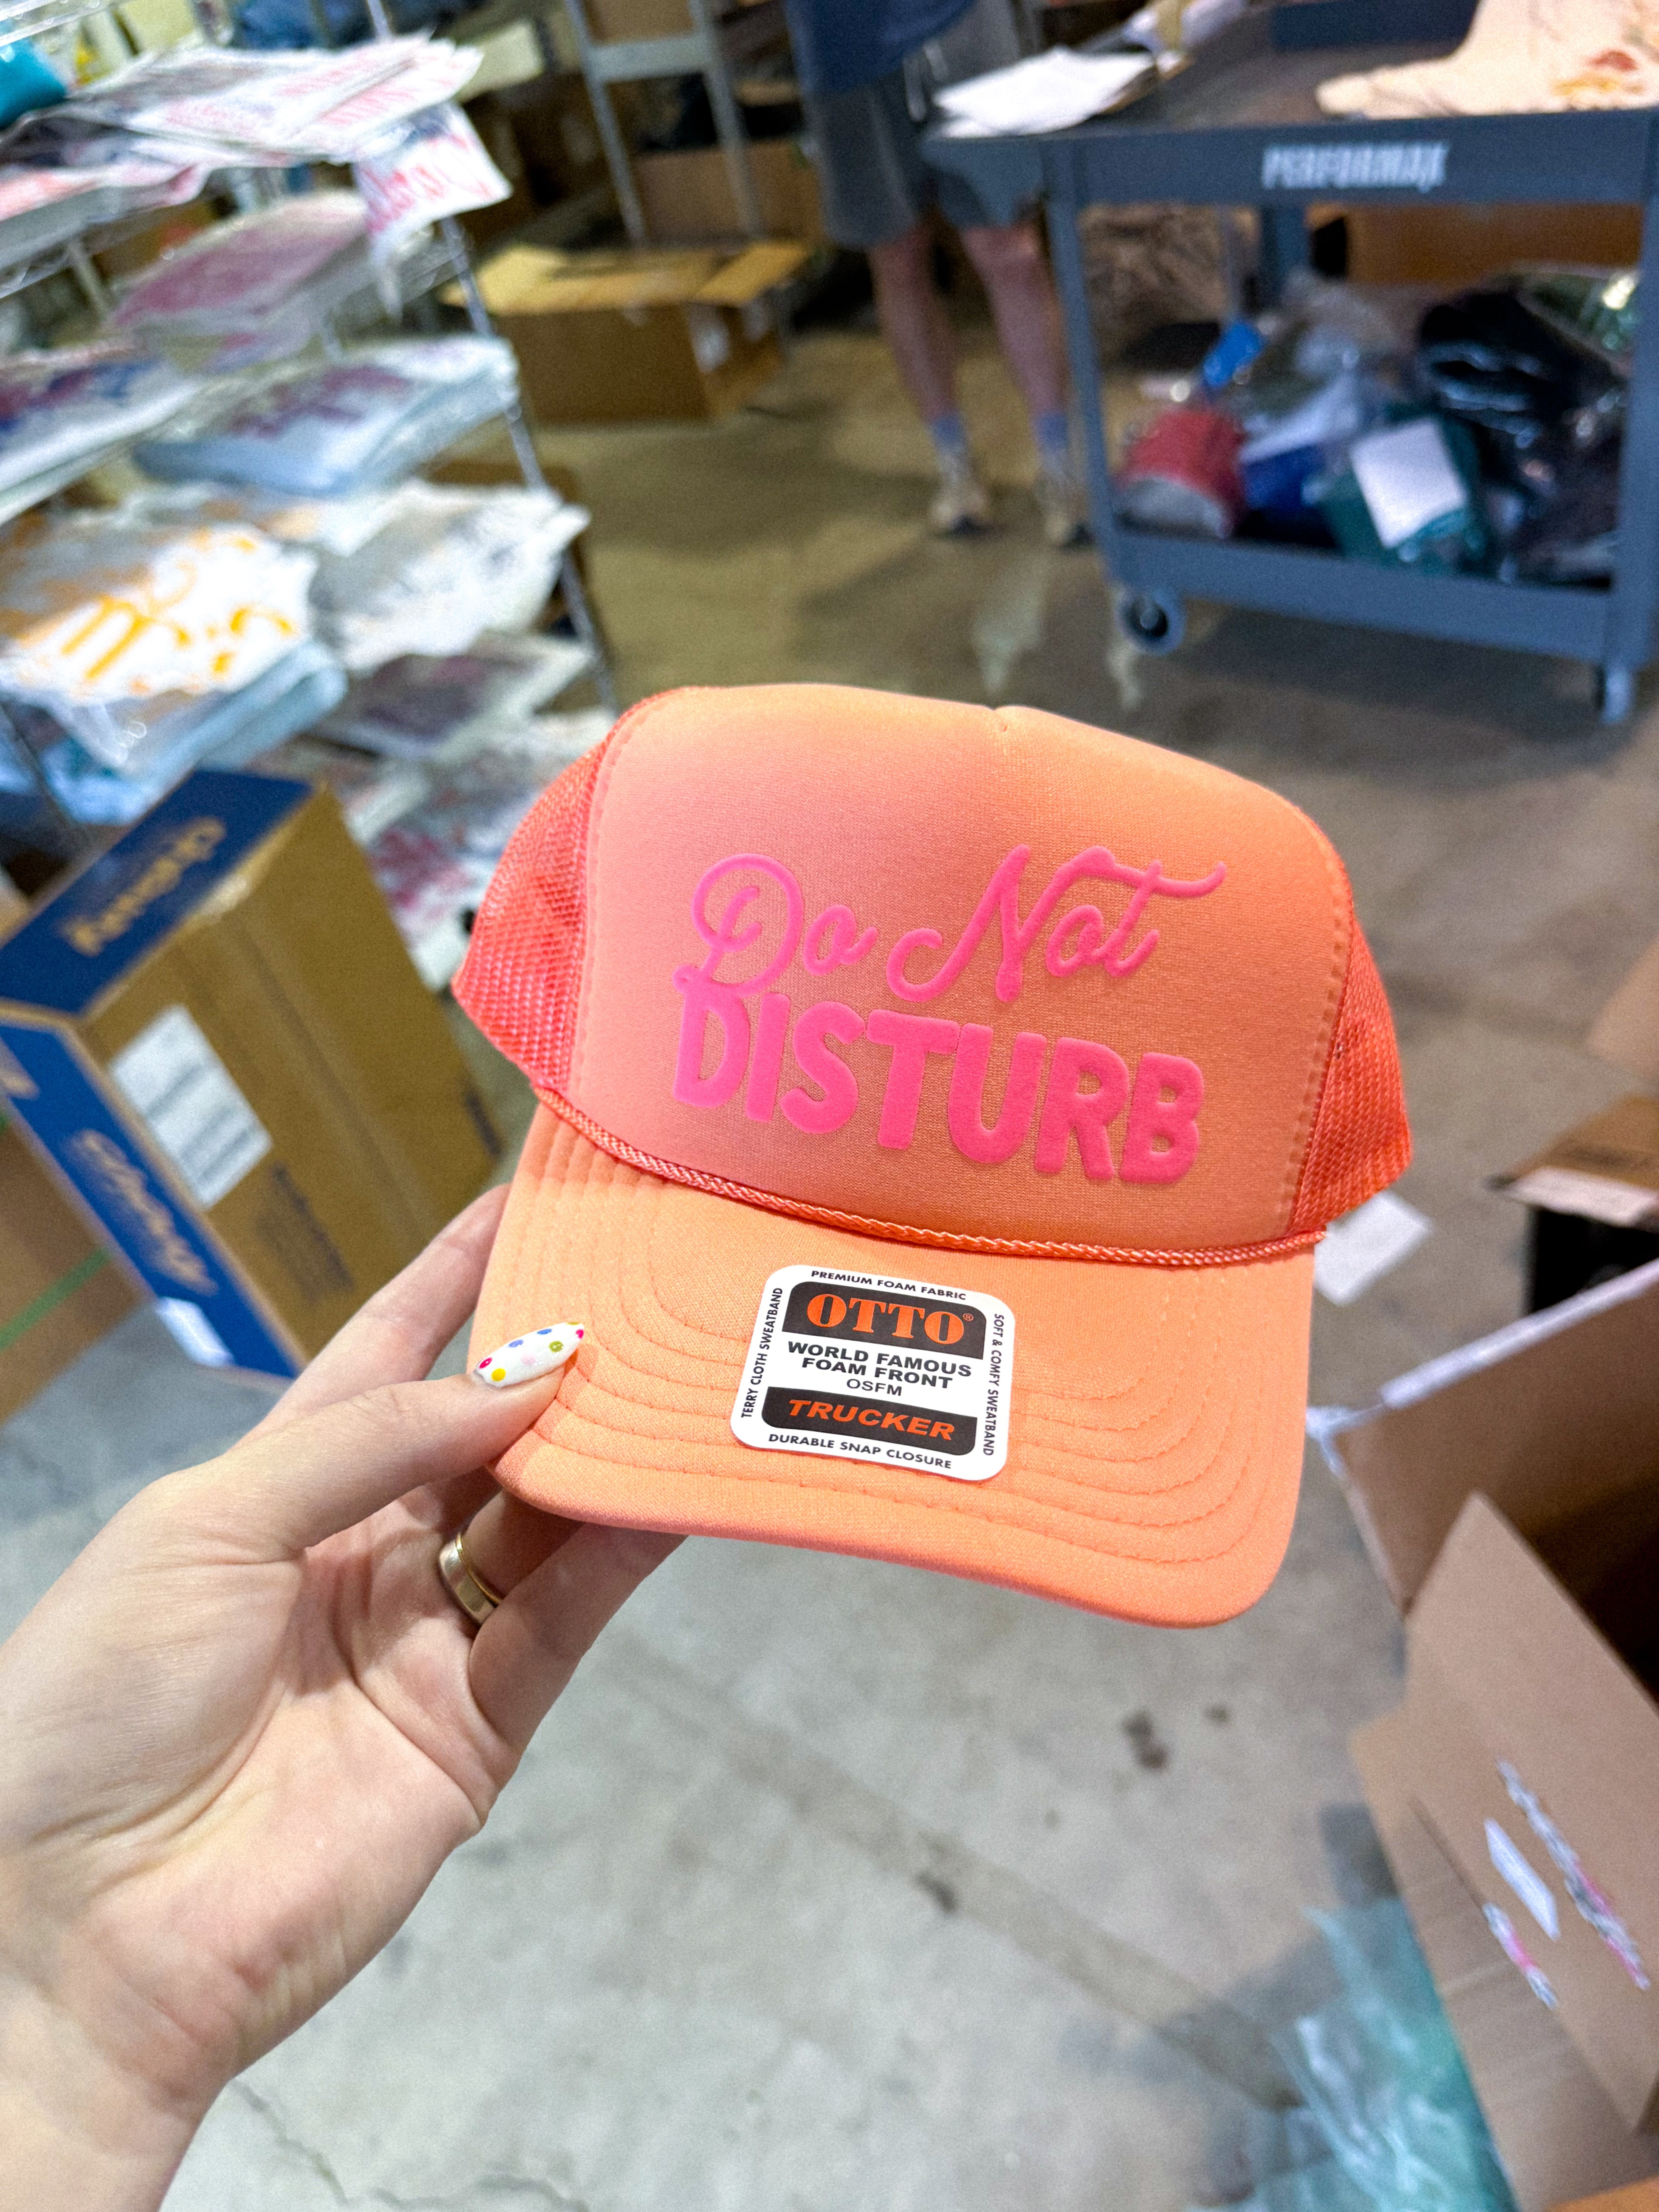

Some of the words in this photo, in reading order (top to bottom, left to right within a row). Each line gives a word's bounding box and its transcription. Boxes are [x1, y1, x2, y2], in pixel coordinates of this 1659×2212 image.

[672, 853, 877, 998] Do
[886, 845, 1226, 1002] Not
[673, 986, 1204, 1184] DISTURB
[811, 1271, 872, 1285] PREMIUM
[877, 1280, 916, 1291] FOAM
[921, 1286, 966, 1300] FABRIC
[993, 1313, 1004, 1337] SOFT
[741, 1388, 758, 1418] TERRY
[750, 1353, 768, 1385] CLOTH
[759, 1288, 783, 1350] SWEATBAND
[788, 1341, 869, 1362] WORLD
[877, 1353, 971, 1377] FAMOUS
[989, 1350, 1001, 1386] COMFY
[802, 1357, 866, 1375] FOAM
[874, 1367, 953, 1388] FRONT
[847, 1379, 902, 1396] OSFM
[789, 1400, 955, 1440] TRUCKER
[983, 1389, 999, 1456] SWEATBAND
[768, 1434, 835, 1448] DURABLE
[840, 1442, 881, 1455] SNAP
[886, 1449, 951, 1469] CLOSURE
